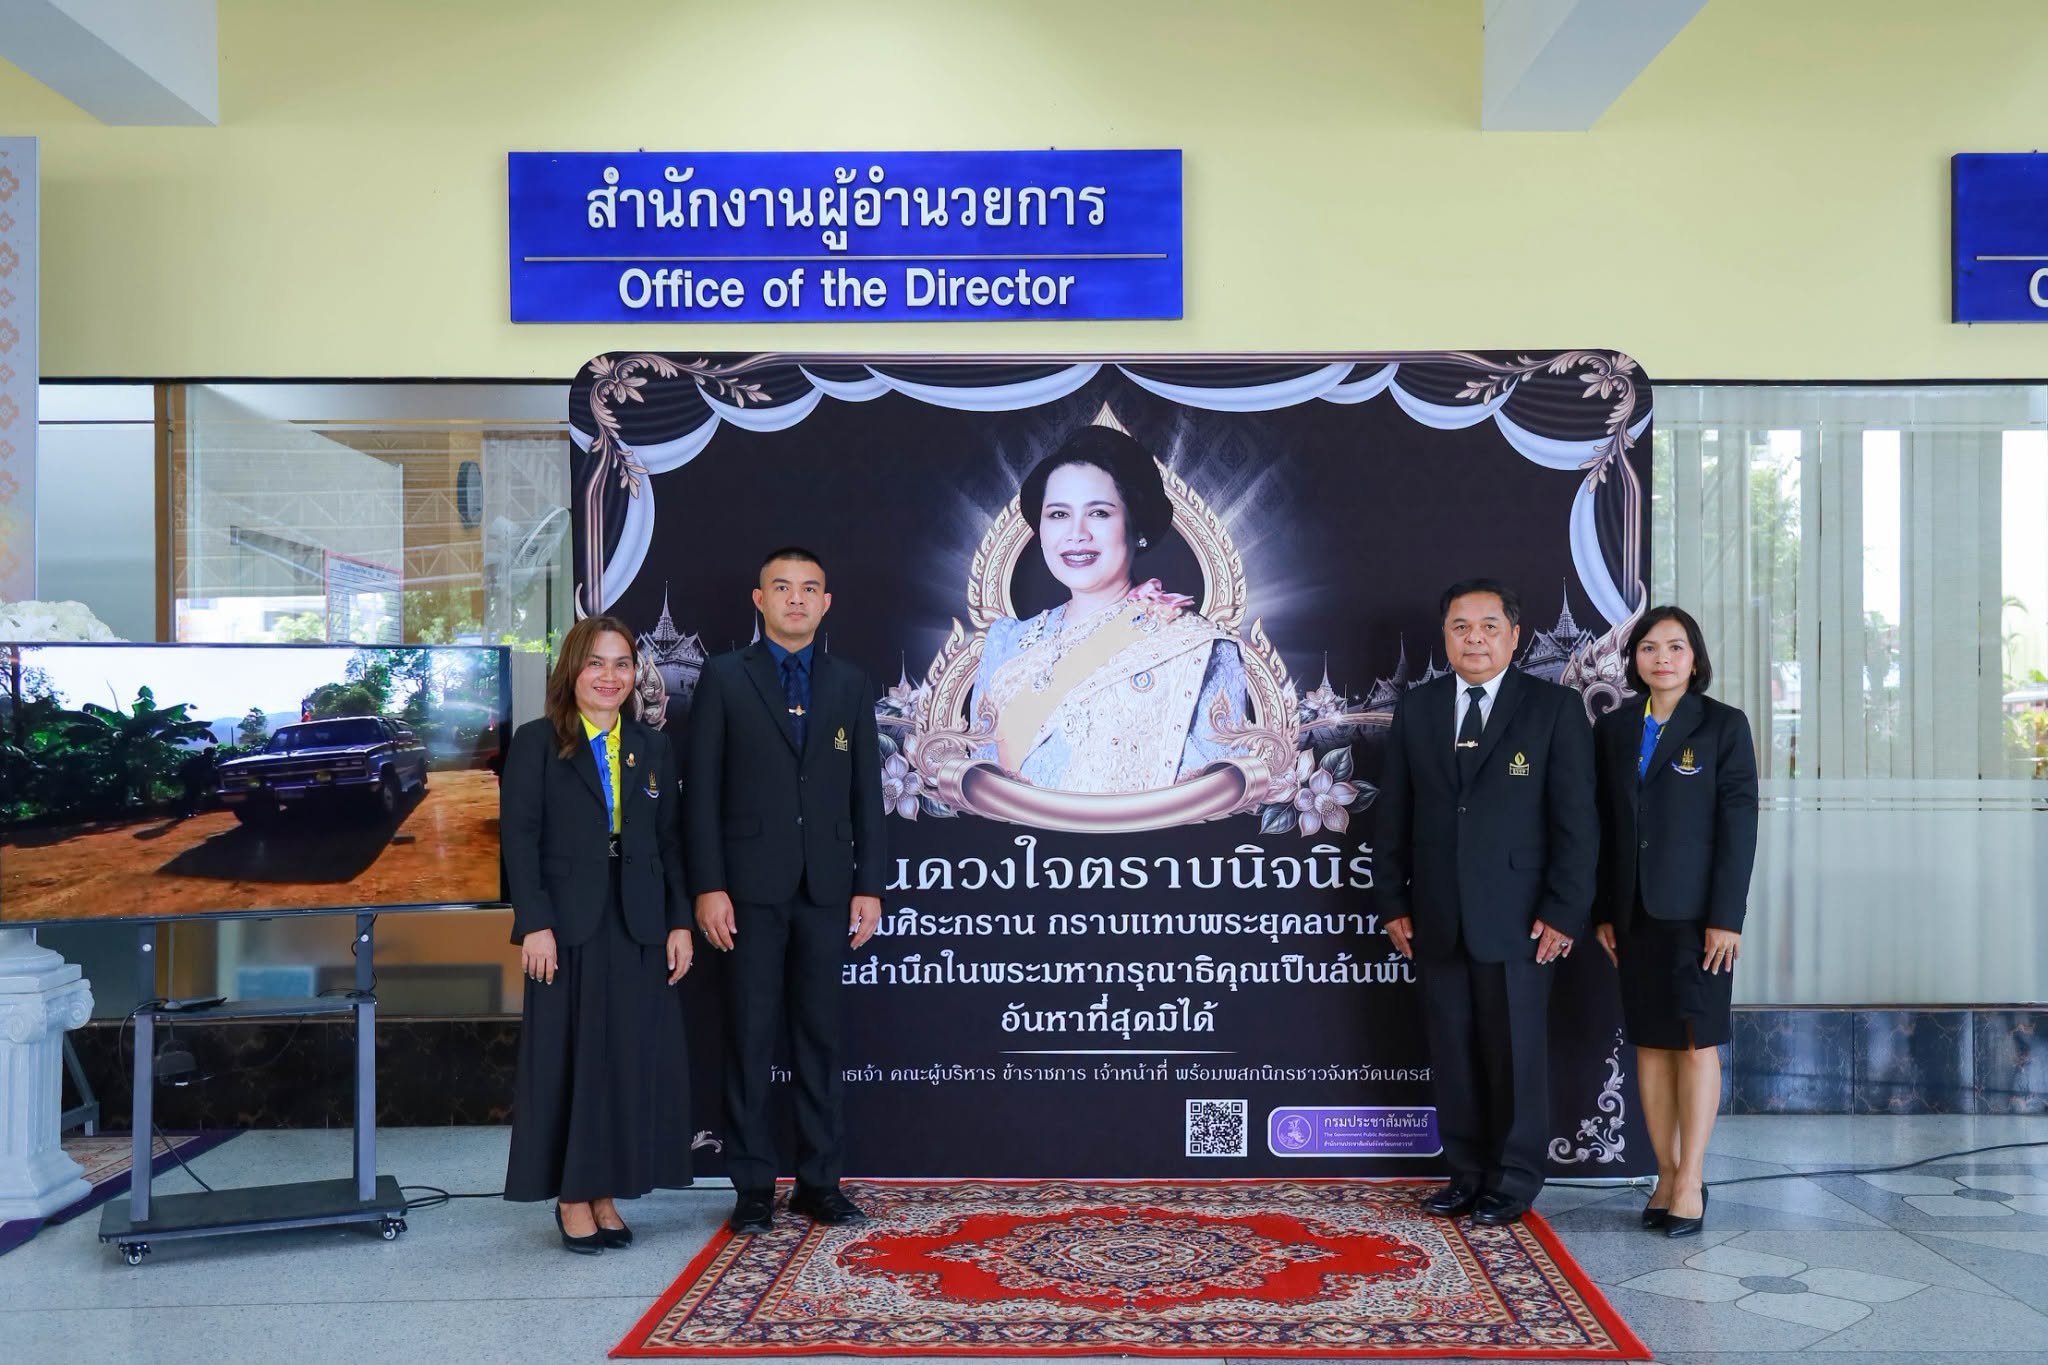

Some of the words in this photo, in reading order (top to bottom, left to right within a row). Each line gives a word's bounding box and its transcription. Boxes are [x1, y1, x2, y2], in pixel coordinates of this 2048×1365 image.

[586, 166, 1107, 251] สำนักงานผู้อำนวยการ
[619, 267, 745, 308] Office
[762, 268, 805, 307] of
[820, 268, 887, 307] the
[905, 267, 1075, 307] Director
[1001, 993, 1218, 1040] อันหาที่สุดมิได้
[890, 1063, 996, 1086] คณะผู้บริหาร
[1002, 1063, 1087, 1082] ข้าราชการ
[1093, 1058, 1168, 1081] เจ้าหน้าที่
[1175, 1063, 1432, 1082] พร้อมพสกนิกรชาวจังหวัดนครส
[1323, 1113, 1429, 1129] กรมประชาสัมพันธ์
